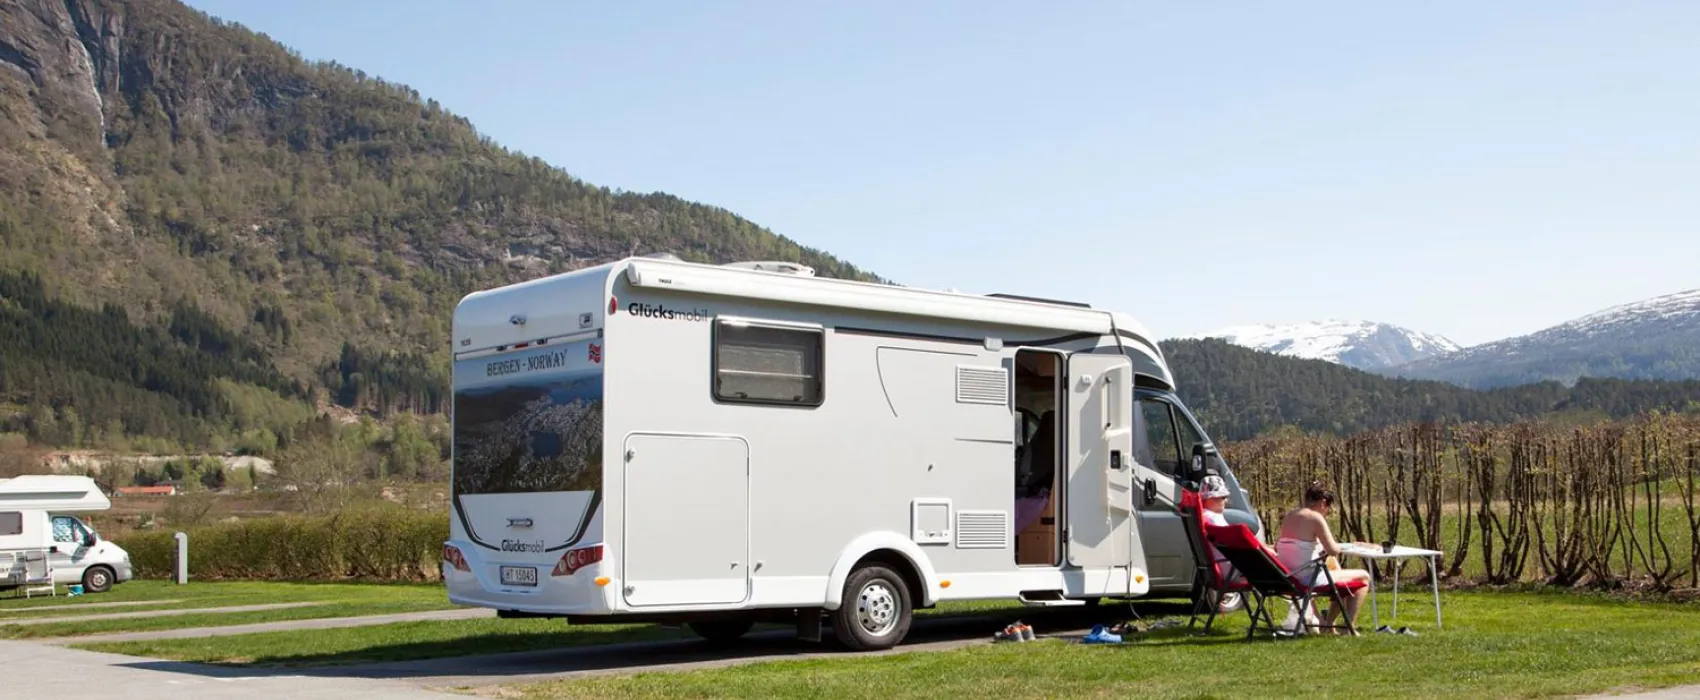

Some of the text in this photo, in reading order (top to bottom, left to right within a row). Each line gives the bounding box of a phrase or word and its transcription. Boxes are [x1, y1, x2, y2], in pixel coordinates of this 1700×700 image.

[628, 302, 708, 322] Glücksmobil
[486, 359, 520, 377] BERGEN
[527, 348, 568, 371] NORWAY
[501, 539, 544, 553] Glücksmobil
